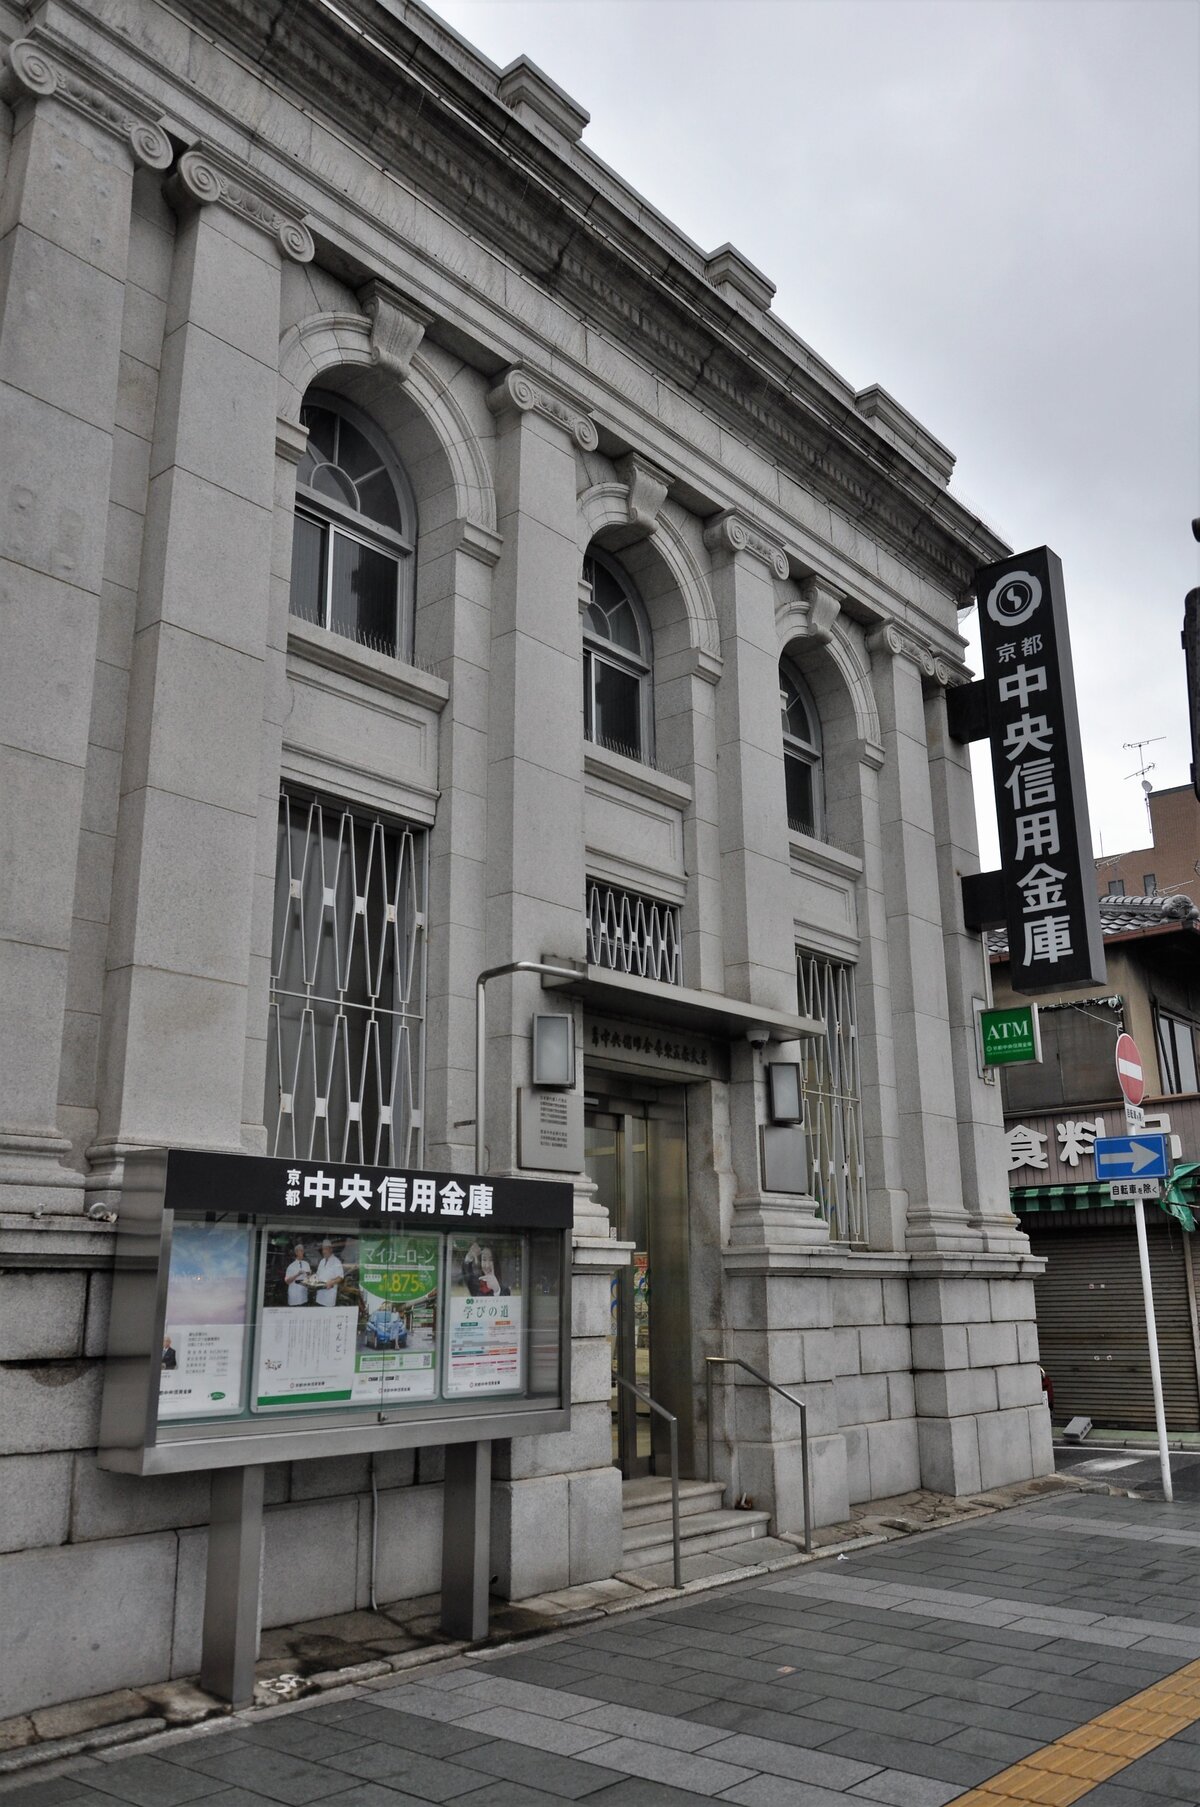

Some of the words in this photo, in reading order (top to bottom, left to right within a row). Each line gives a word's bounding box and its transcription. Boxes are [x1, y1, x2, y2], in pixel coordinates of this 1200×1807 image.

[996, 633, 1043, 663] 京都
[998, 664, 1074, 968] 中央信用金庫
[987, 1020, 1029, 1040] ATM
[285, 1169, 301, 1207] 京都
[303, 1170, 494, 1217] 中央信用金庫
[1112, 1183, 1158, 1196] 自転車を除く
[364, 1247, 434, 1264] マイカーローン
[463, 1305, 509, 1319] 学びの道
